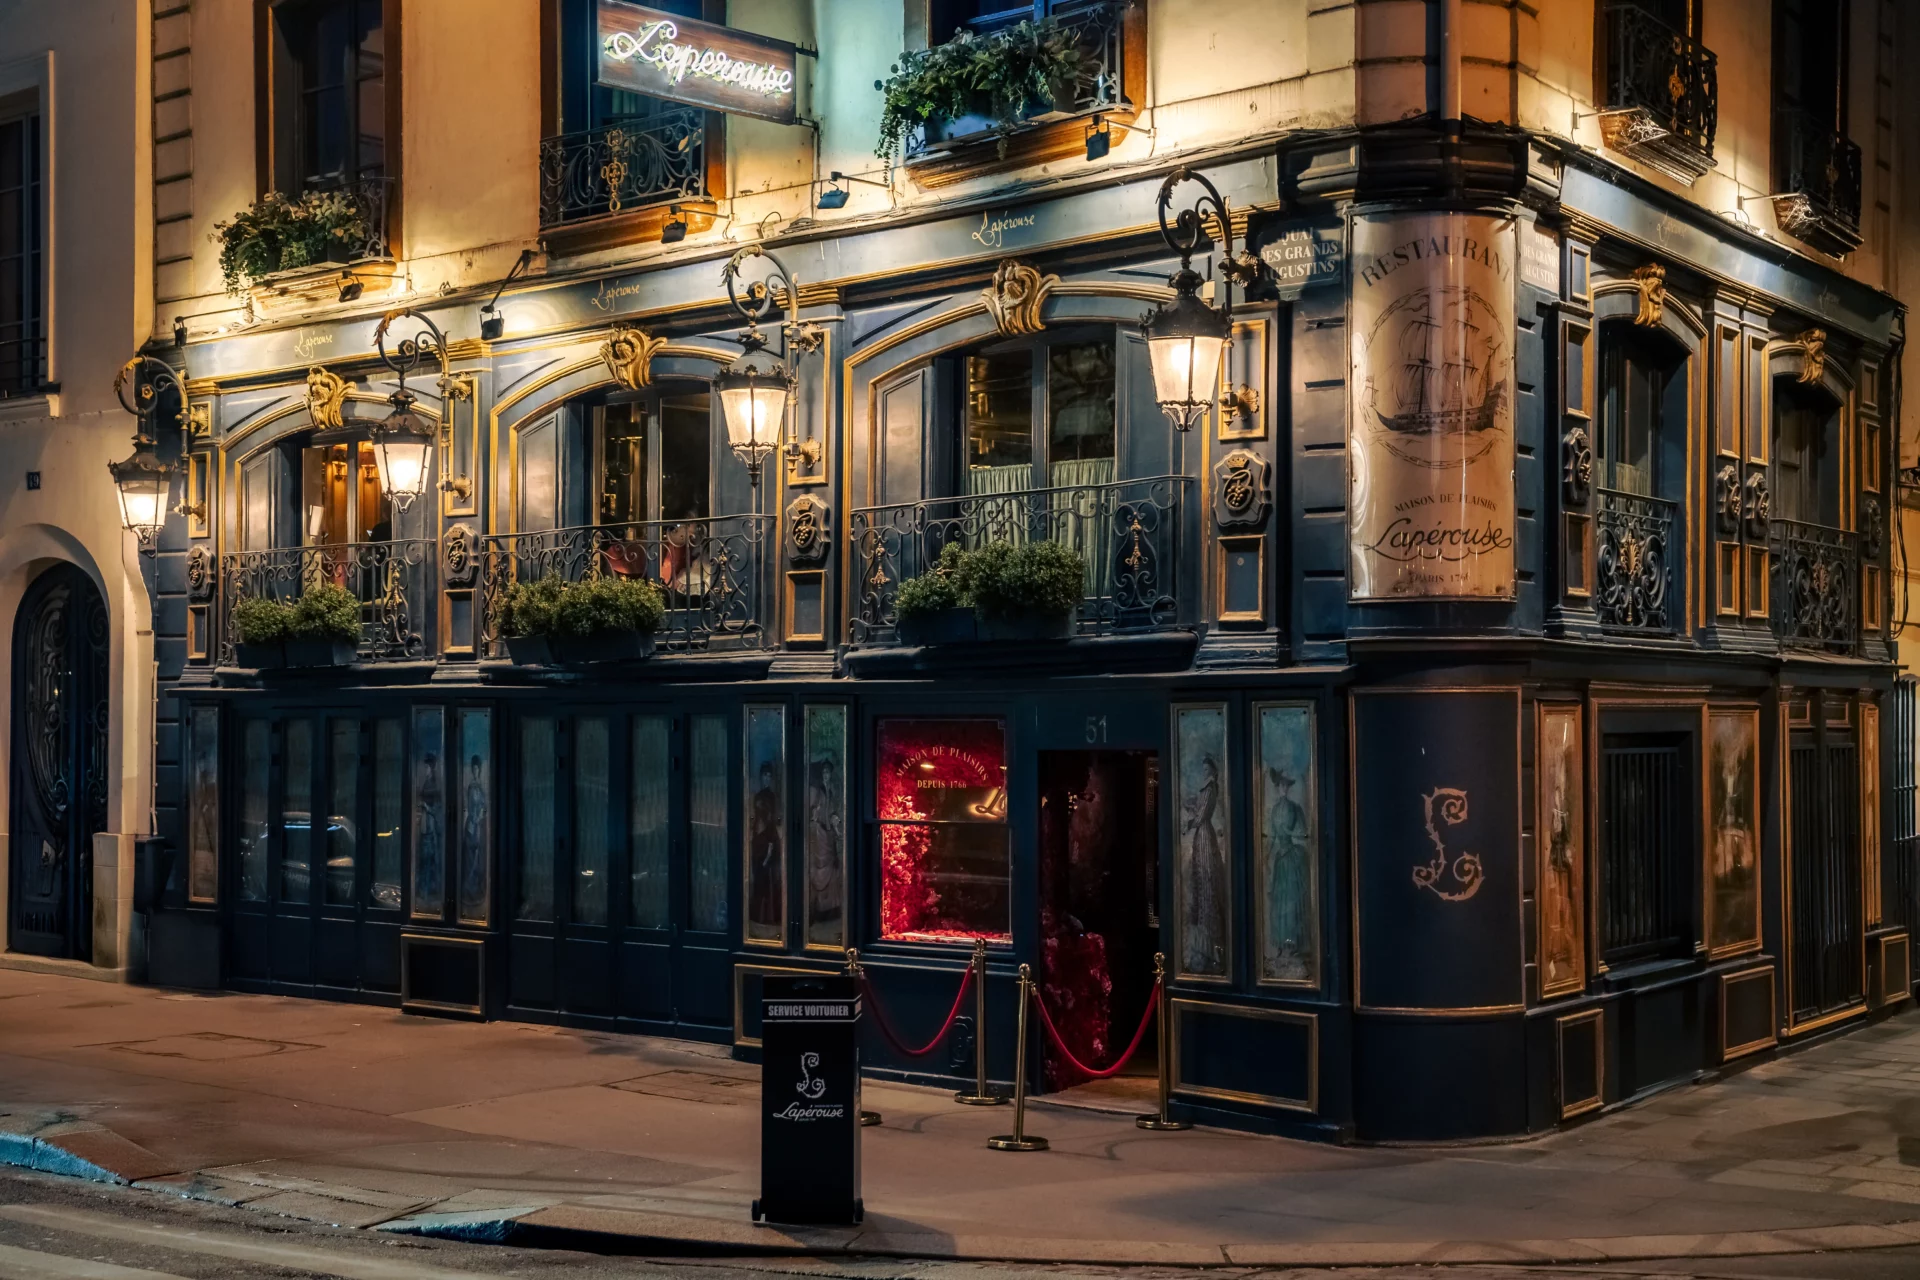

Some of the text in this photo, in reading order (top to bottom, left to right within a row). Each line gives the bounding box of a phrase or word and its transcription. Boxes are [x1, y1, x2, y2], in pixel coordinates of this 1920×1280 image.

[971, 210, 1035, 248] Lapérouse
[1281, 226, 1314, 246] QUAI
[1284, 240, 1339, 260] GRANDS
[1262, 260, 1335, 281] AUGUSTINS
[1361, 235, 1510, 287] RESTAURANT
[591, 280, 640, 312] Lapérouse
[1394, 494, 1497, 513] MAISON DE PLAISIRS
[1362, 517, 1512, 561] Lapérouse
[1085, 714, 1107, 744] 51
[896, 746, 989, 781] MAISON DE PLAISIRS
[917, 779, 967, 789] DEPUIS 1766
[768, 1005, 849, 1016] SERVICE VOITURIER
[772, 1101, 844, 1121] Lapérouse
